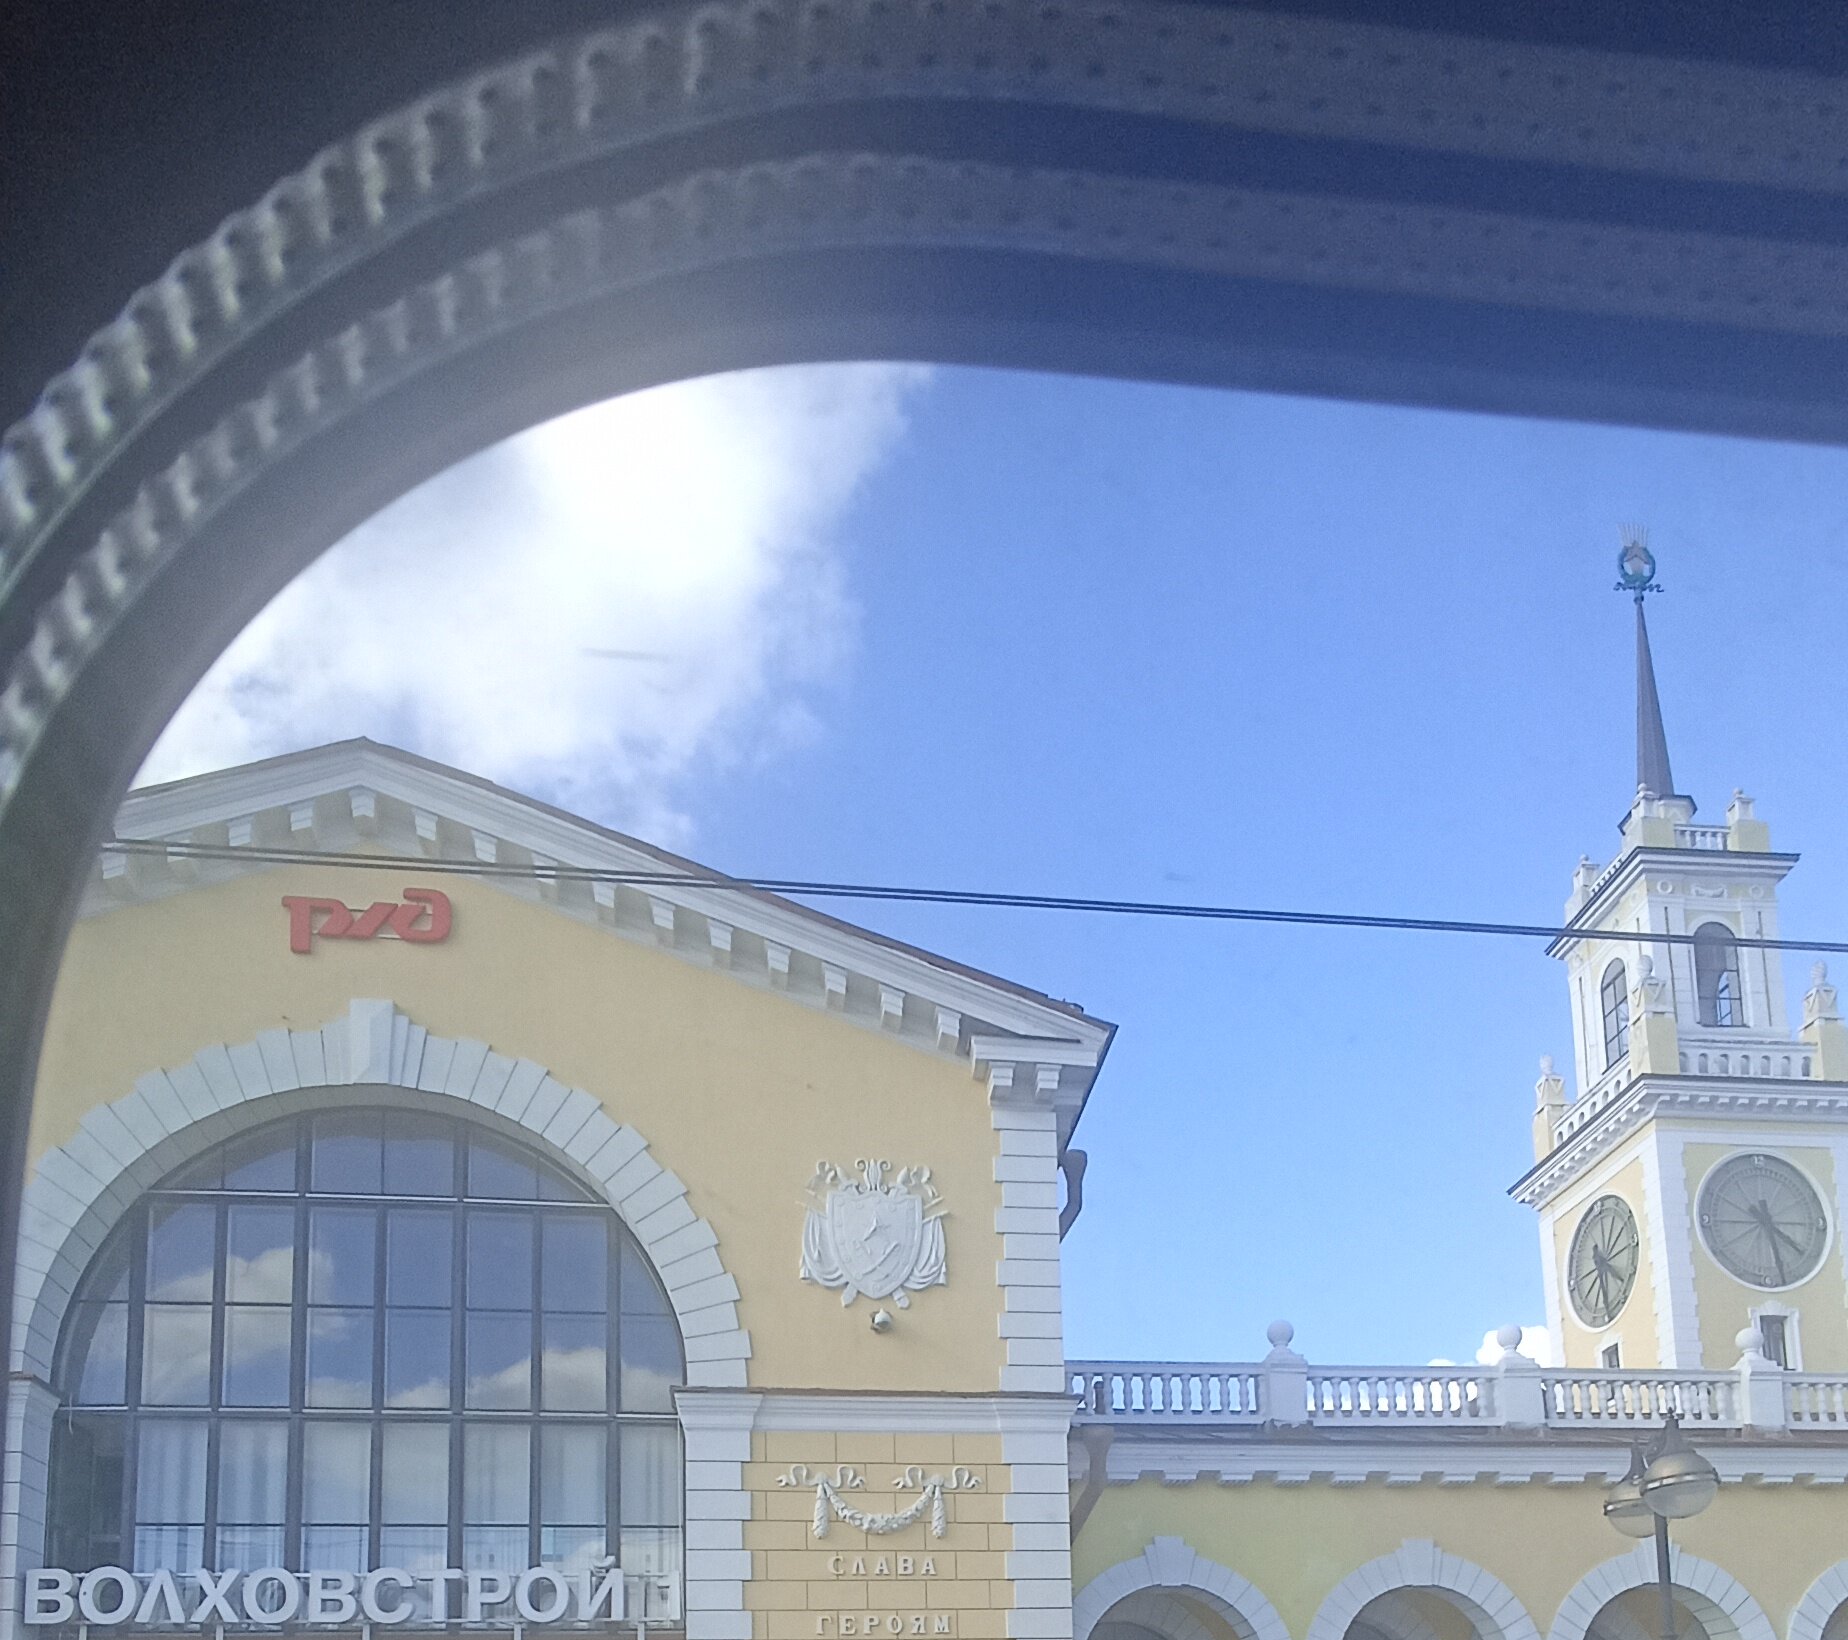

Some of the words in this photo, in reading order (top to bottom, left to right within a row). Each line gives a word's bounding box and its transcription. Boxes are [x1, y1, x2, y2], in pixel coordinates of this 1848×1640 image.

[829, 1554, 938, 1577] СЛАВА
[24, 1556, 624, 1625] ВОЛХОВСТРОЙ
[816, 1614, 951, 1636] ГЕРОЯМ
